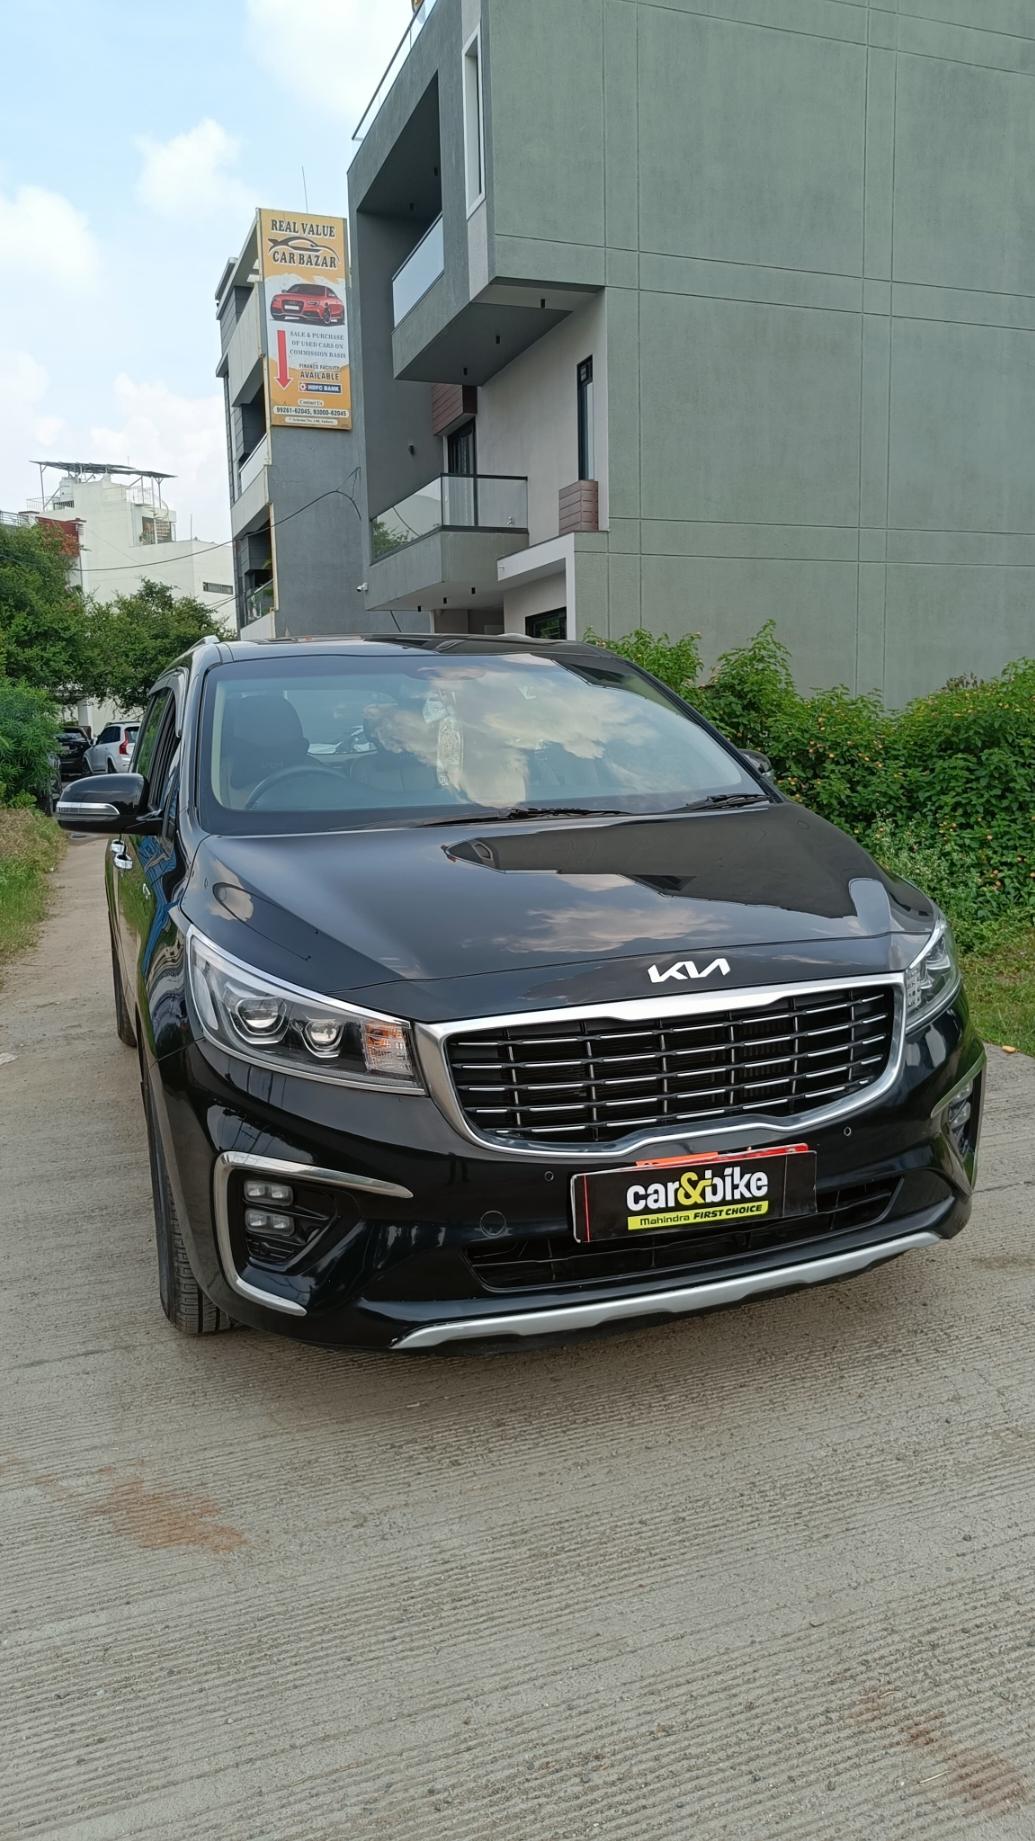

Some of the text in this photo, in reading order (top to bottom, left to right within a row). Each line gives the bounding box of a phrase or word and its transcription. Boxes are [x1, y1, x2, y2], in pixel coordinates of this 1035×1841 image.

[271, 219, 336, 237] REAL VALUE
[272, 251, 337, 268] CAR BAZAR
[312, 332, 344, 340] PURCHASE
[289, 349, 328, 357] COMMISSION
[300, 371, 340, 380] AVAILABLE
[648, 958, 730, 983] KIA
[626, 1167, 768, 1212] car&bike
[640, 1204, 763, 1226] Mahindra FIRST CHOICE
